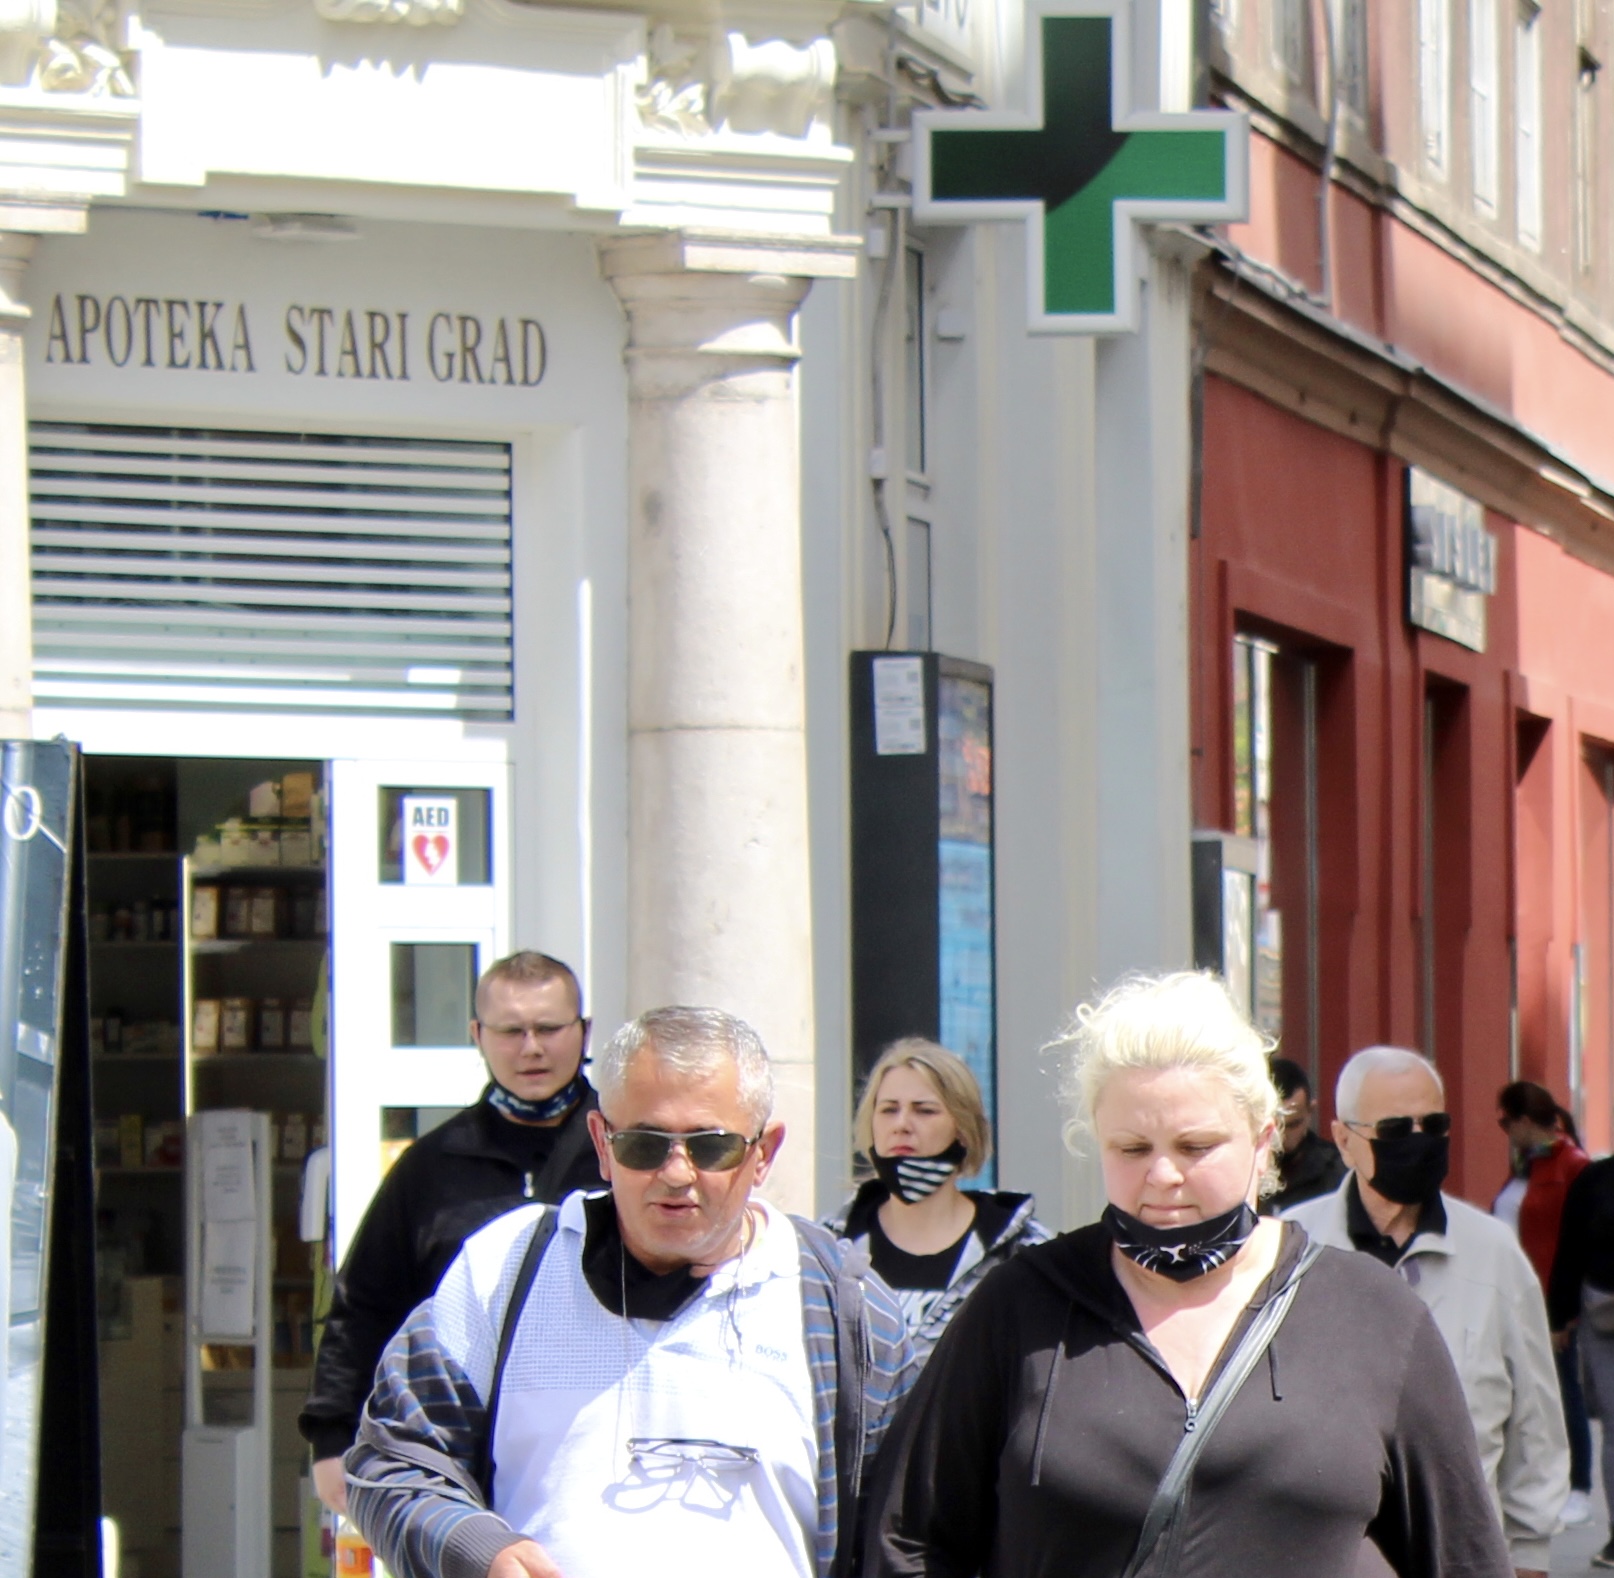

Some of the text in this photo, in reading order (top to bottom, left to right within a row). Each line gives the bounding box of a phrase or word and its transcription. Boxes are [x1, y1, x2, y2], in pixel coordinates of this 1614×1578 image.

[45, 292, 548, 388] APOTEKA STARI GRAD
[412, 806, 450, 827] AED
